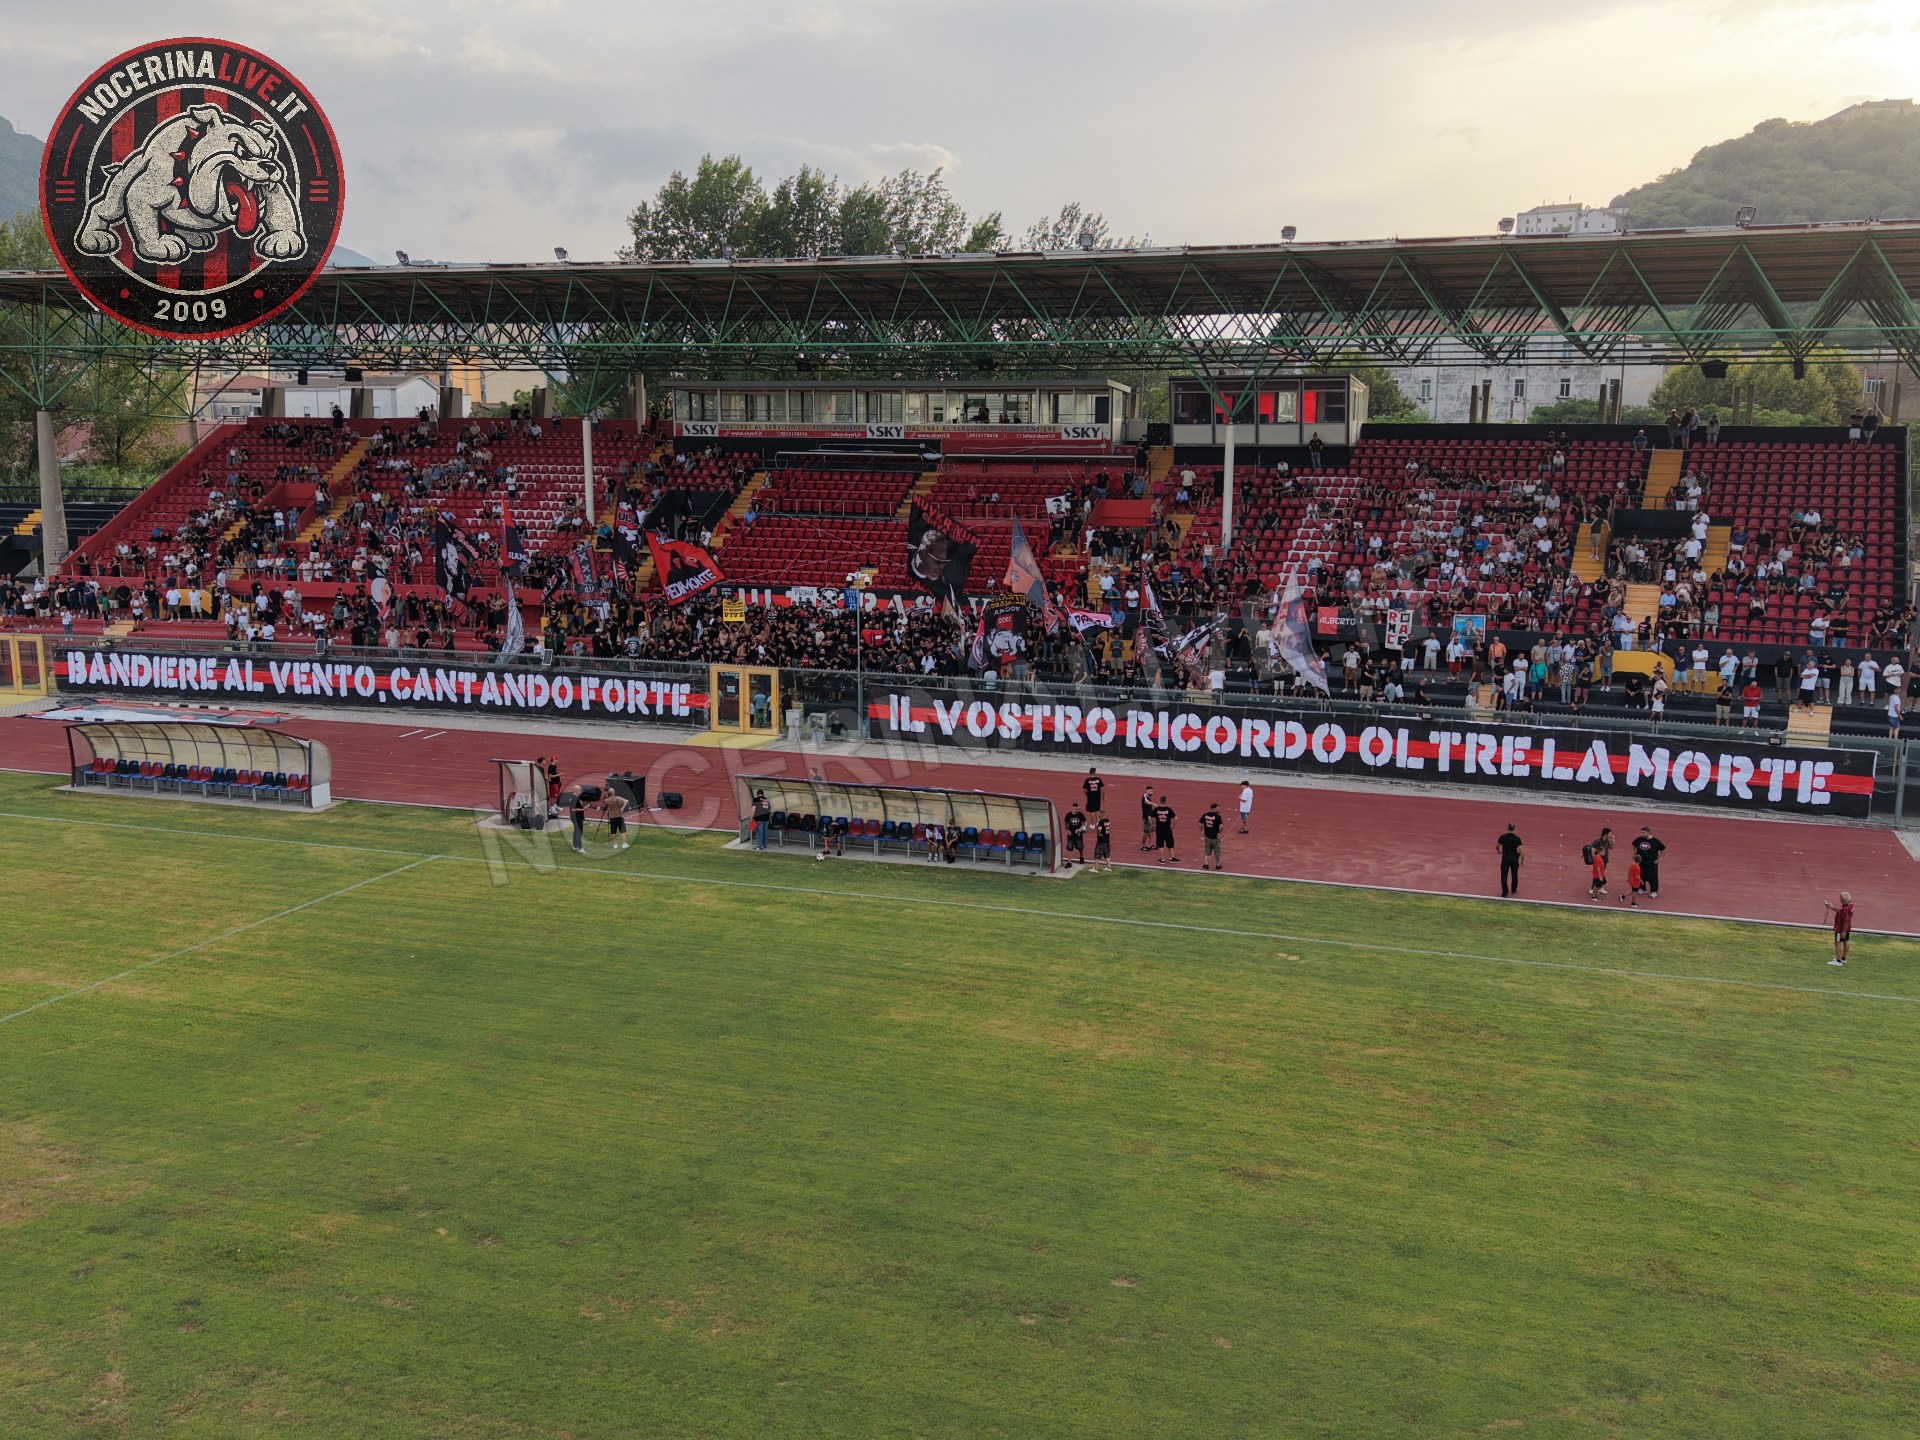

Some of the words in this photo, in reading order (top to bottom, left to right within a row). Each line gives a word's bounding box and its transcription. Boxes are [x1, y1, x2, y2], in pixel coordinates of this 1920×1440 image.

[692, 424, 717, 435] SKY
[876, 426, 903, 437] SKY
[1072, 426, 1101, 438] SKY
[1319, 616, 1356, 626] ALBERTO
[67, 651, 218, 690] BANDIERE
[224, 658, 264, 692] AL
[390, 666, 574, 709] CANTANDO
[580, 676, 691, 717] FORTE
[889, 694, 926, 733] IL
[933, 698, 1117, 746] VOSTRO
[1125, 709, 1347, 764] RICORDO
[1358, 725, 1532, 778] OLTRE
[1541, 737, 1615, 785] LA
[1625, 742, 1835, 805] MORTE
